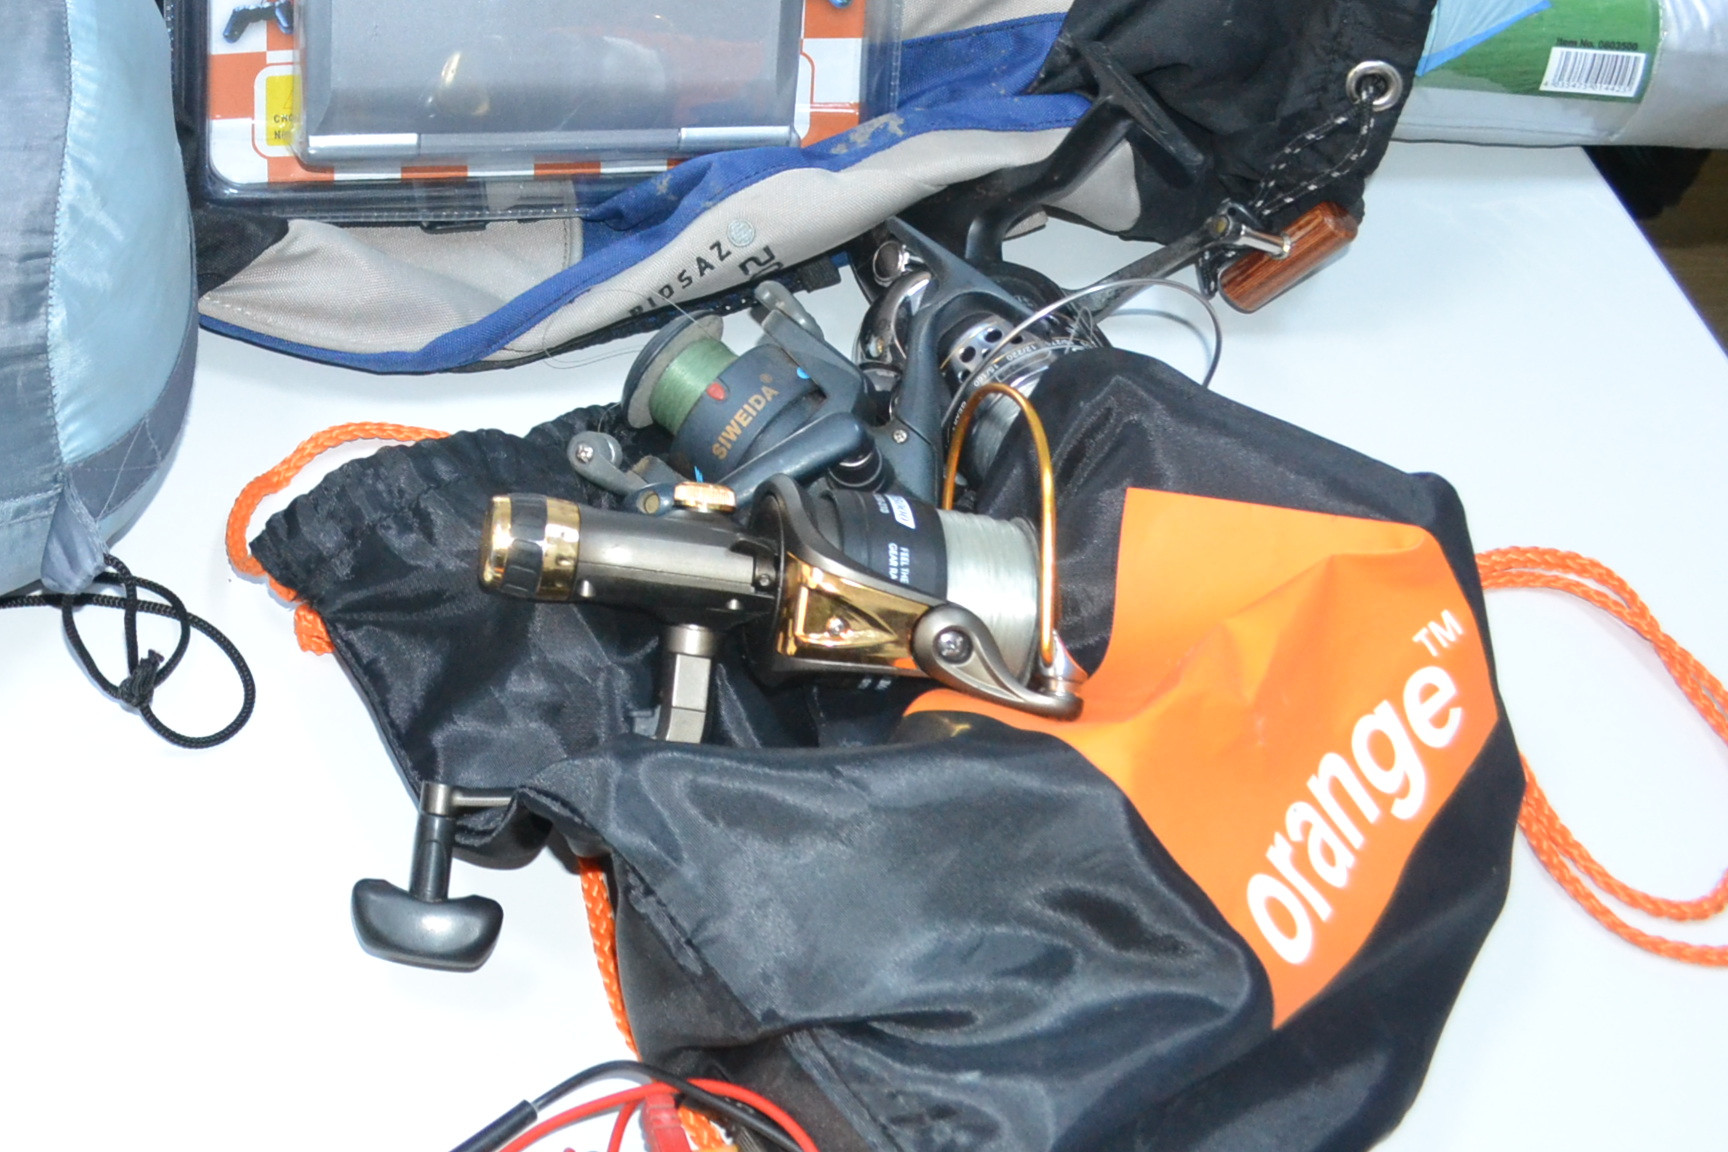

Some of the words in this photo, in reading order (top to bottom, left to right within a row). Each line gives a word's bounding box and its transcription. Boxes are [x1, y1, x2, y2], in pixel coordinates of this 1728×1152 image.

[888, 542, 899, 567] GEAR
[899, 546, 910, 566] FEEL
[888, 567, 899, 580] RA
[899, 567, 910, 584] THE
[1245, 662, 1464, 966] orange
